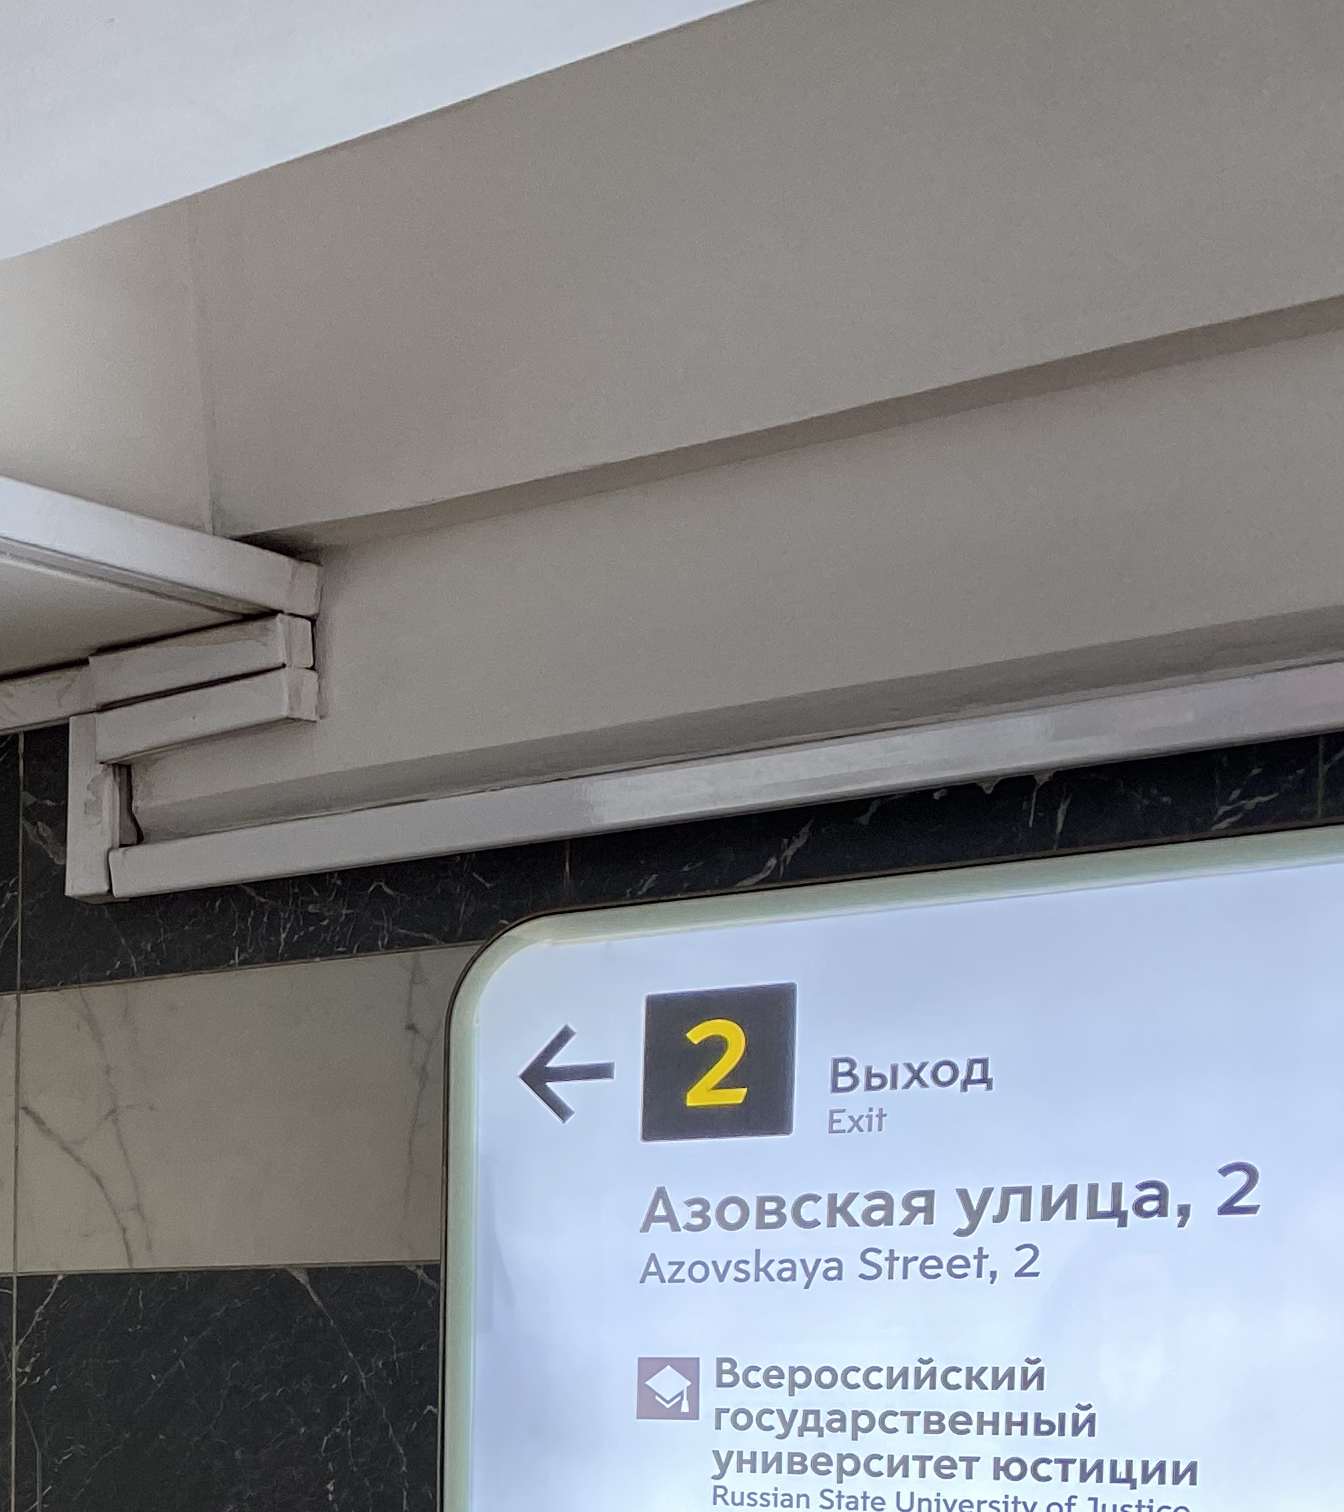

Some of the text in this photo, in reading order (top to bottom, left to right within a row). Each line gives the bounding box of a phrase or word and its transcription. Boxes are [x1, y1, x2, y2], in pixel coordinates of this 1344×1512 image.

[685, 1019, 748, 1107] 2
[830, 1056, 994, 1094] Выход
[828, 1108, 887, 1133] Exit
[640, 1162, 1261, 1237] Азовская улица, 2
[640, 1244, 1041, 1289] Azovskaya Street, 2
[714, 1356, 1045, 1396] Всероссийский
[713, 1403, 1096, 1441] государственный
[711, 1447, 1199, 1489] университет юстиции
[712, 1485, 810, 1509] Russian
[819, 1488, 886, 1512] State
